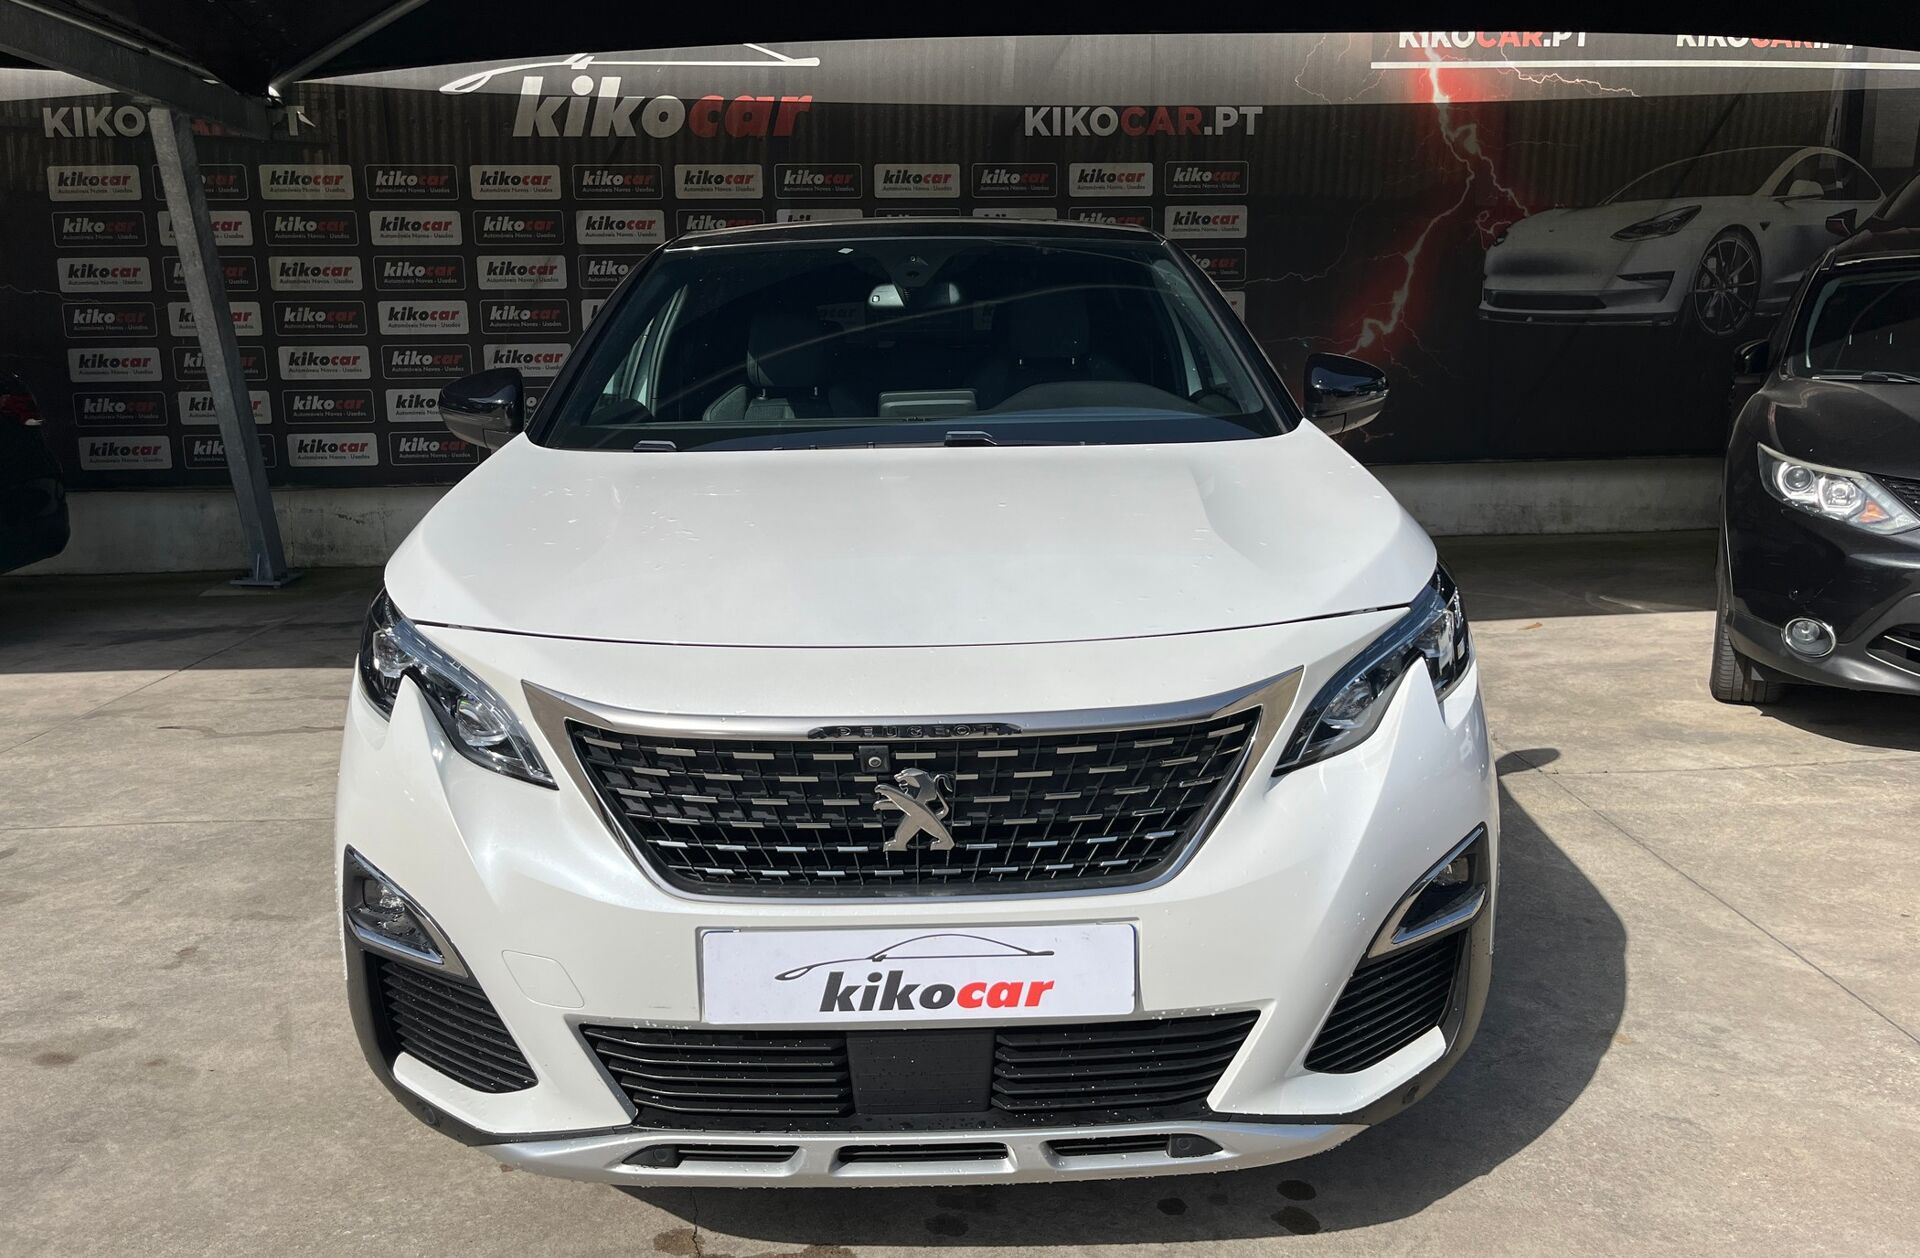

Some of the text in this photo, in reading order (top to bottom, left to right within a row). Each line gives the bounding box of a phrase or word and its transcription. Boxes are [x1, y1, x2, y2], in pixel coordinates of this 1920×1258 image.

[512, 75, 813, 138] kikocar
[1024, 106, 1264, 137] KIKOCAR.PT
[57, 171, 130, 186] kikocar
[271, 171, 343, 186] kikocar
[376, 171, 448, 185] kikocar
[480, 171, 551, 185] kikocar
[582, 171, 653, 185] kikocar
[684, 170, 753, 184] kikocar
[883, 169, 951, 183] kikocar
[1078, 168, 1144, 182] kikocar
[1173, 168, 1239, 182] kikocar
[275, 217, 347, 231] kikocar
[380, 217, 451, 231] kikocar
[483, 217, 554, 230] kikocar
[585, 216, 656, 230] kikocar
[1173, 212, 1238, 226] kikocar
[68, 264, 140, 278] kikocar
[280, 263, 351, 277] kikocar
[384, 262, 455, 276] kikocar
[487, 262, 557, 275] kikocar
[588, 260, 629, 275] kiko
[74, 309, 146, 323] kikocar
[284, 308, 356, 321] kikocar
[388, 307, 459, 320] kikocar
[490, 306, 560, 320] kikocar
[79, 354, 151, 368] kikocar
[289, 352, 360, 366] kikocar
[392, 351, 462, 365] kikocar
[494, 350, 563, 364] kikocar
[293, 396, 364, 409] kikocar
[395, 394, 437, 409] kiko
[90, 442, 162, 456] kikocar
[298, 439, 368, 453] kikocar
[400, 437, 469, 451] kikocar
[819, 971, 1055, 1013] kikocar
